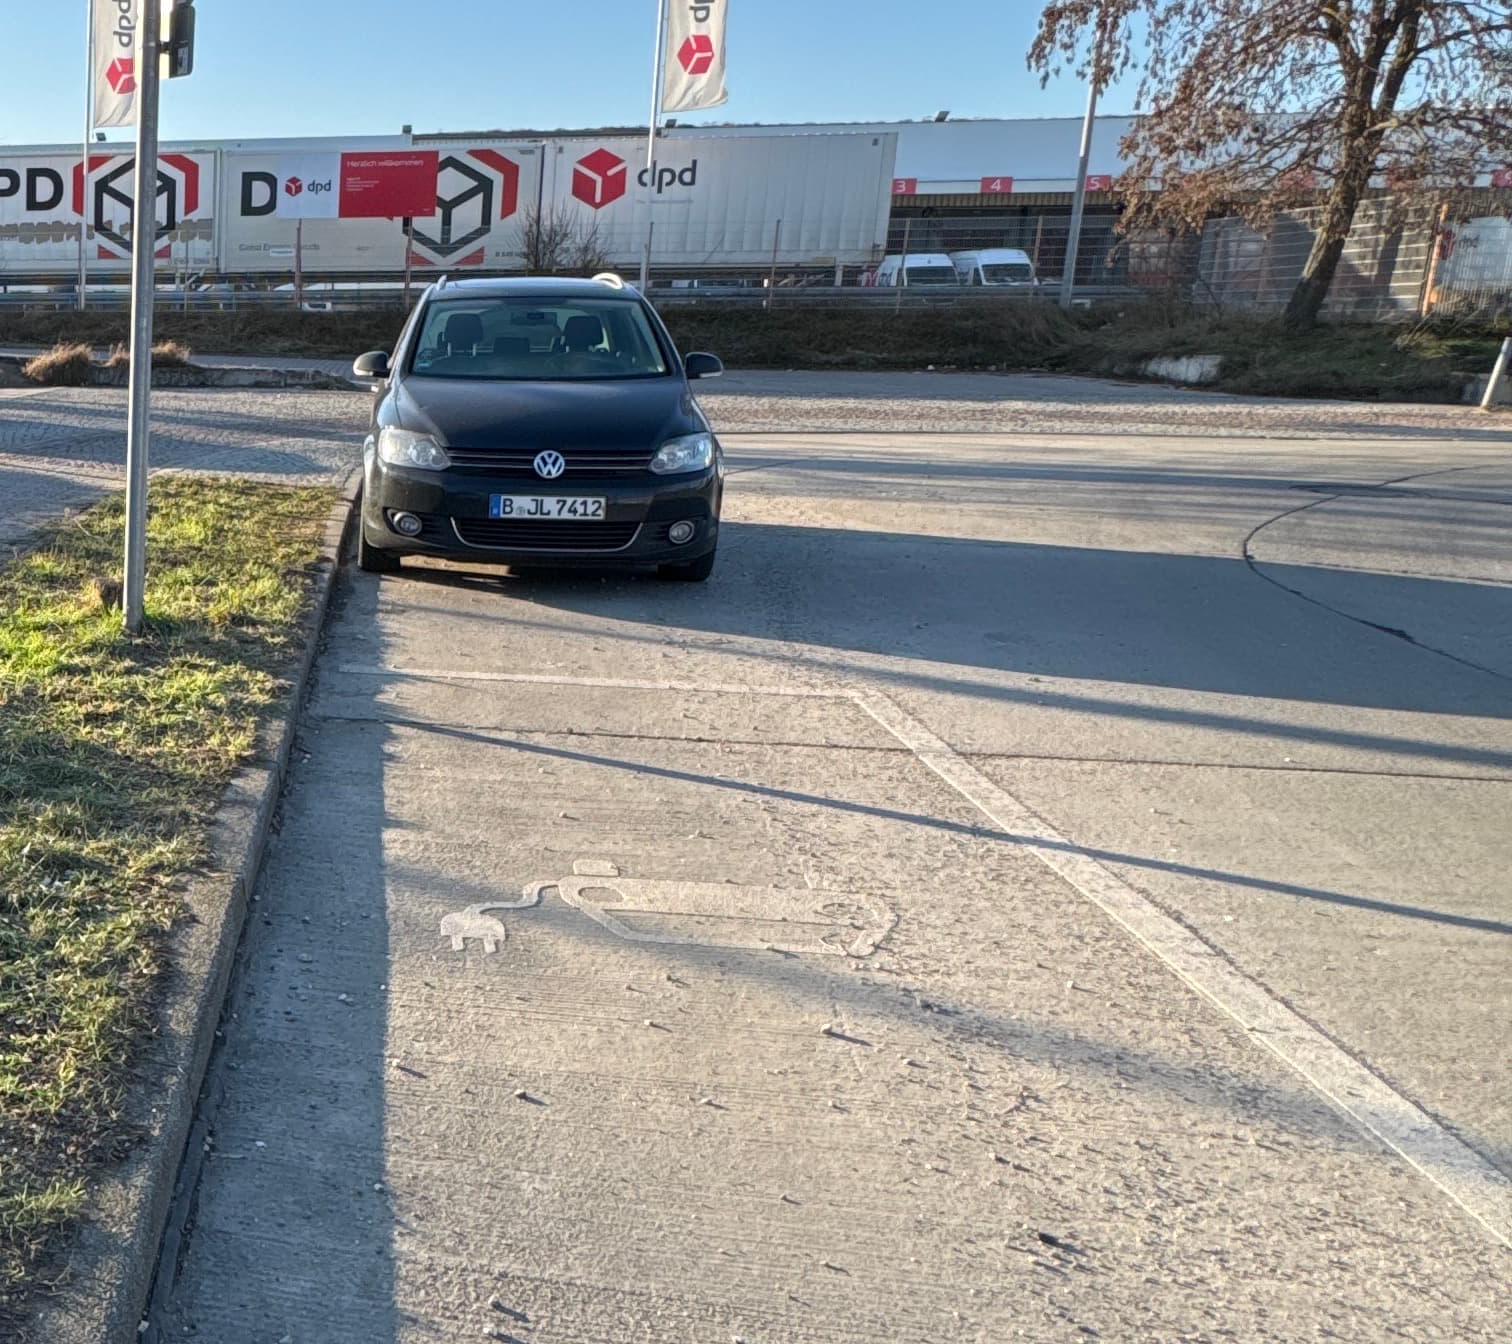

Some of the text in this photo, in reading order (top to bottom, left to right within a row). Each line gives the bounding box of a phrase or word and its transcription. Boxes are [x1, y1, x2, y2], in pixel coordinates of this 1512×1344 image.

[637, 159, 697, 194] dpd
[1089, 176, 1100, 188] 5
[307, 179, 331, 195] dpd
[895, 181, 906, 192] 3
[990, 179, 1001, 191] 4
[556, 499, 602, 517] 7412
